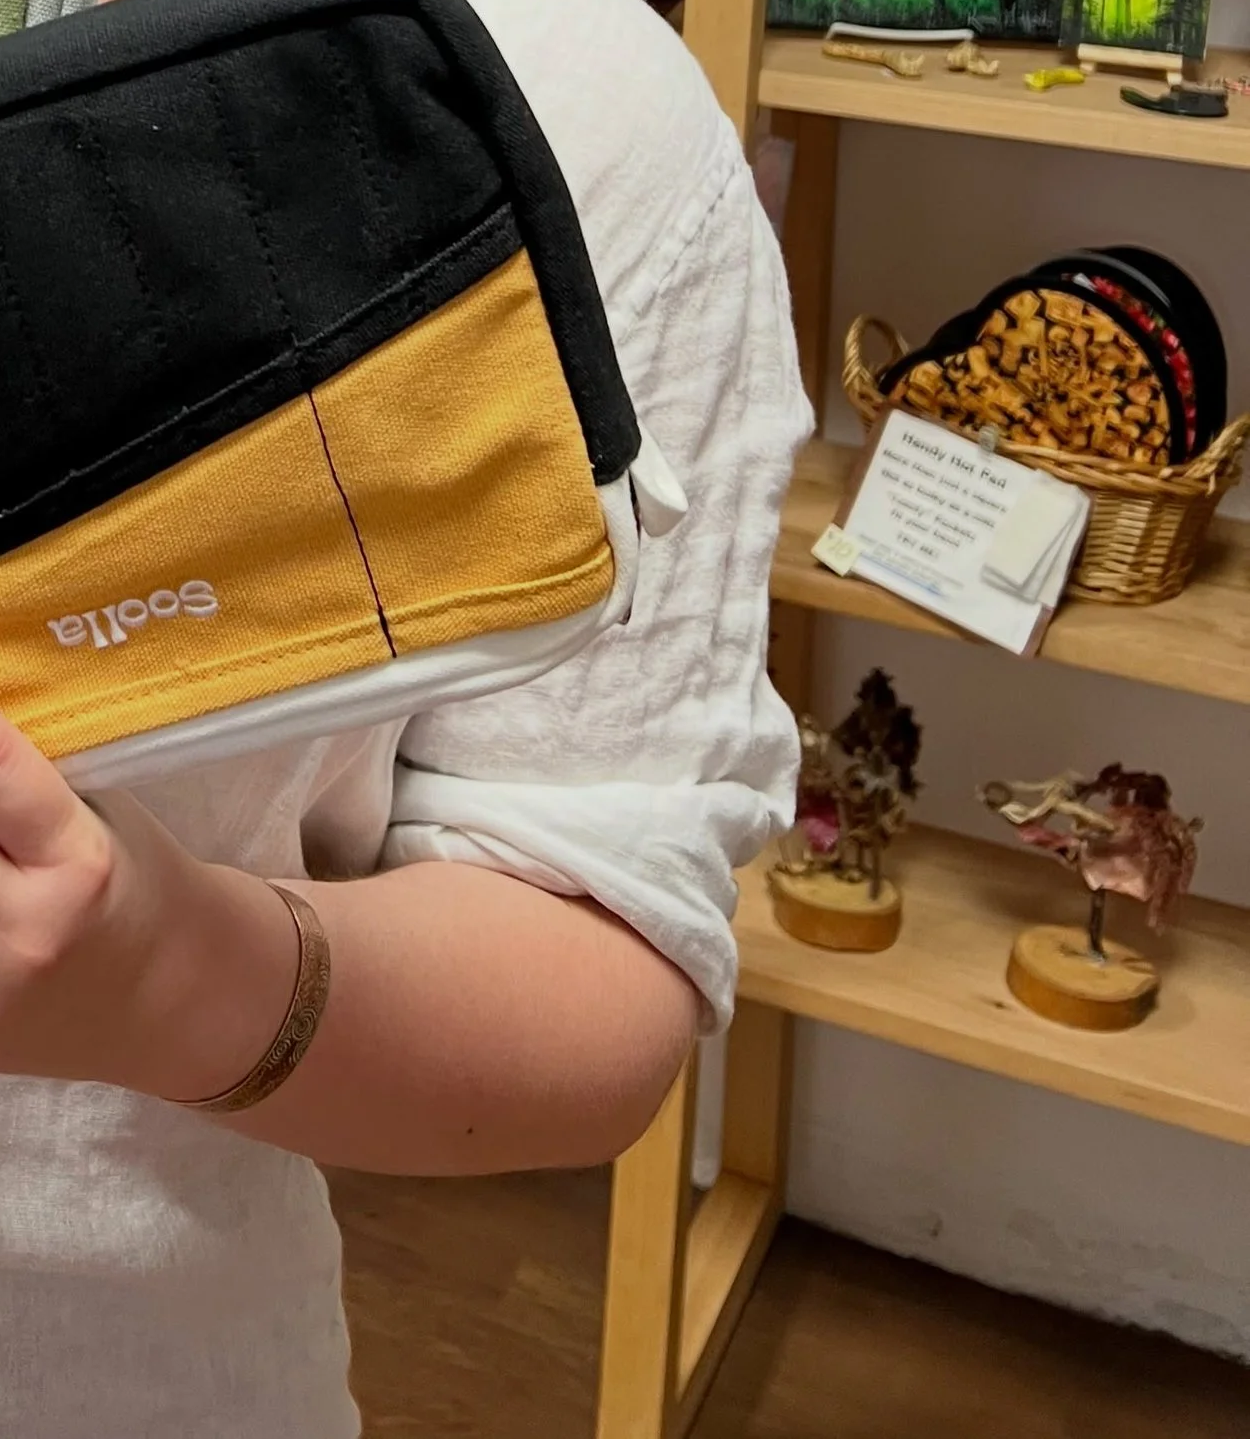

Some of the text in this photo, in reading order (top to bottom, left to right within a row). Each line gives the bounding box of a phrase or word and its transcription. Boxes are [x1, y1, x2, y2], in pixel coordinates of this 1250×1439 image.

[901, 430, 1007, 490] Handy Hot Pad
[47, 579, 219, 649] soolla
